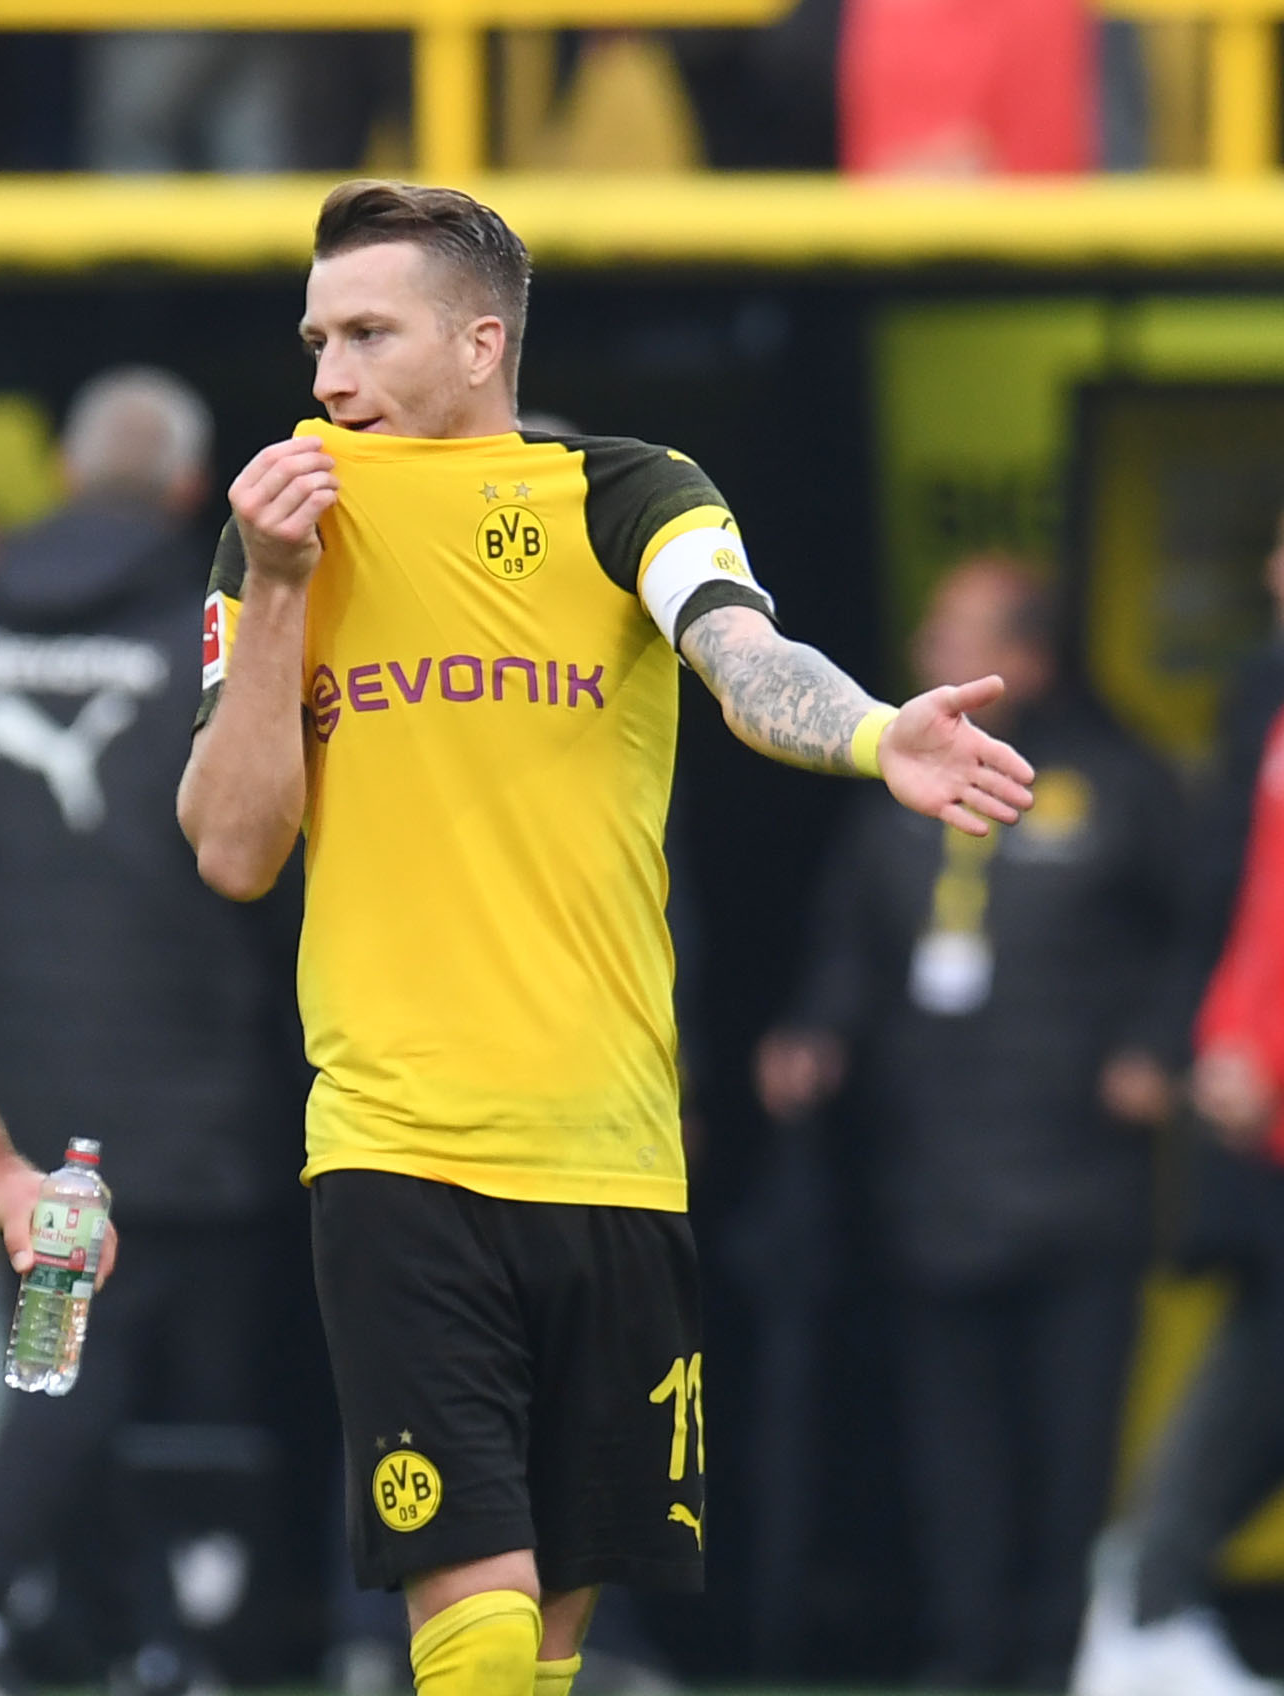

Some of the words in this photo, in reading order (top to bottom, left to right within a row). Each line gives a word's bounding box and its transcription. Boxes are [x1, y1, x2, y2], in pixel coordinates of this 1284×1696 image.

[486, 512, 540, 559] BVB
[503, 557, 523, 574] 09
[347, 654, 605, 713] EVONIK
[649, 1352, 705, 1481] 11
[381, 1460, 432, 1511] BVB
[399, 1504, 418, 1522] 09
